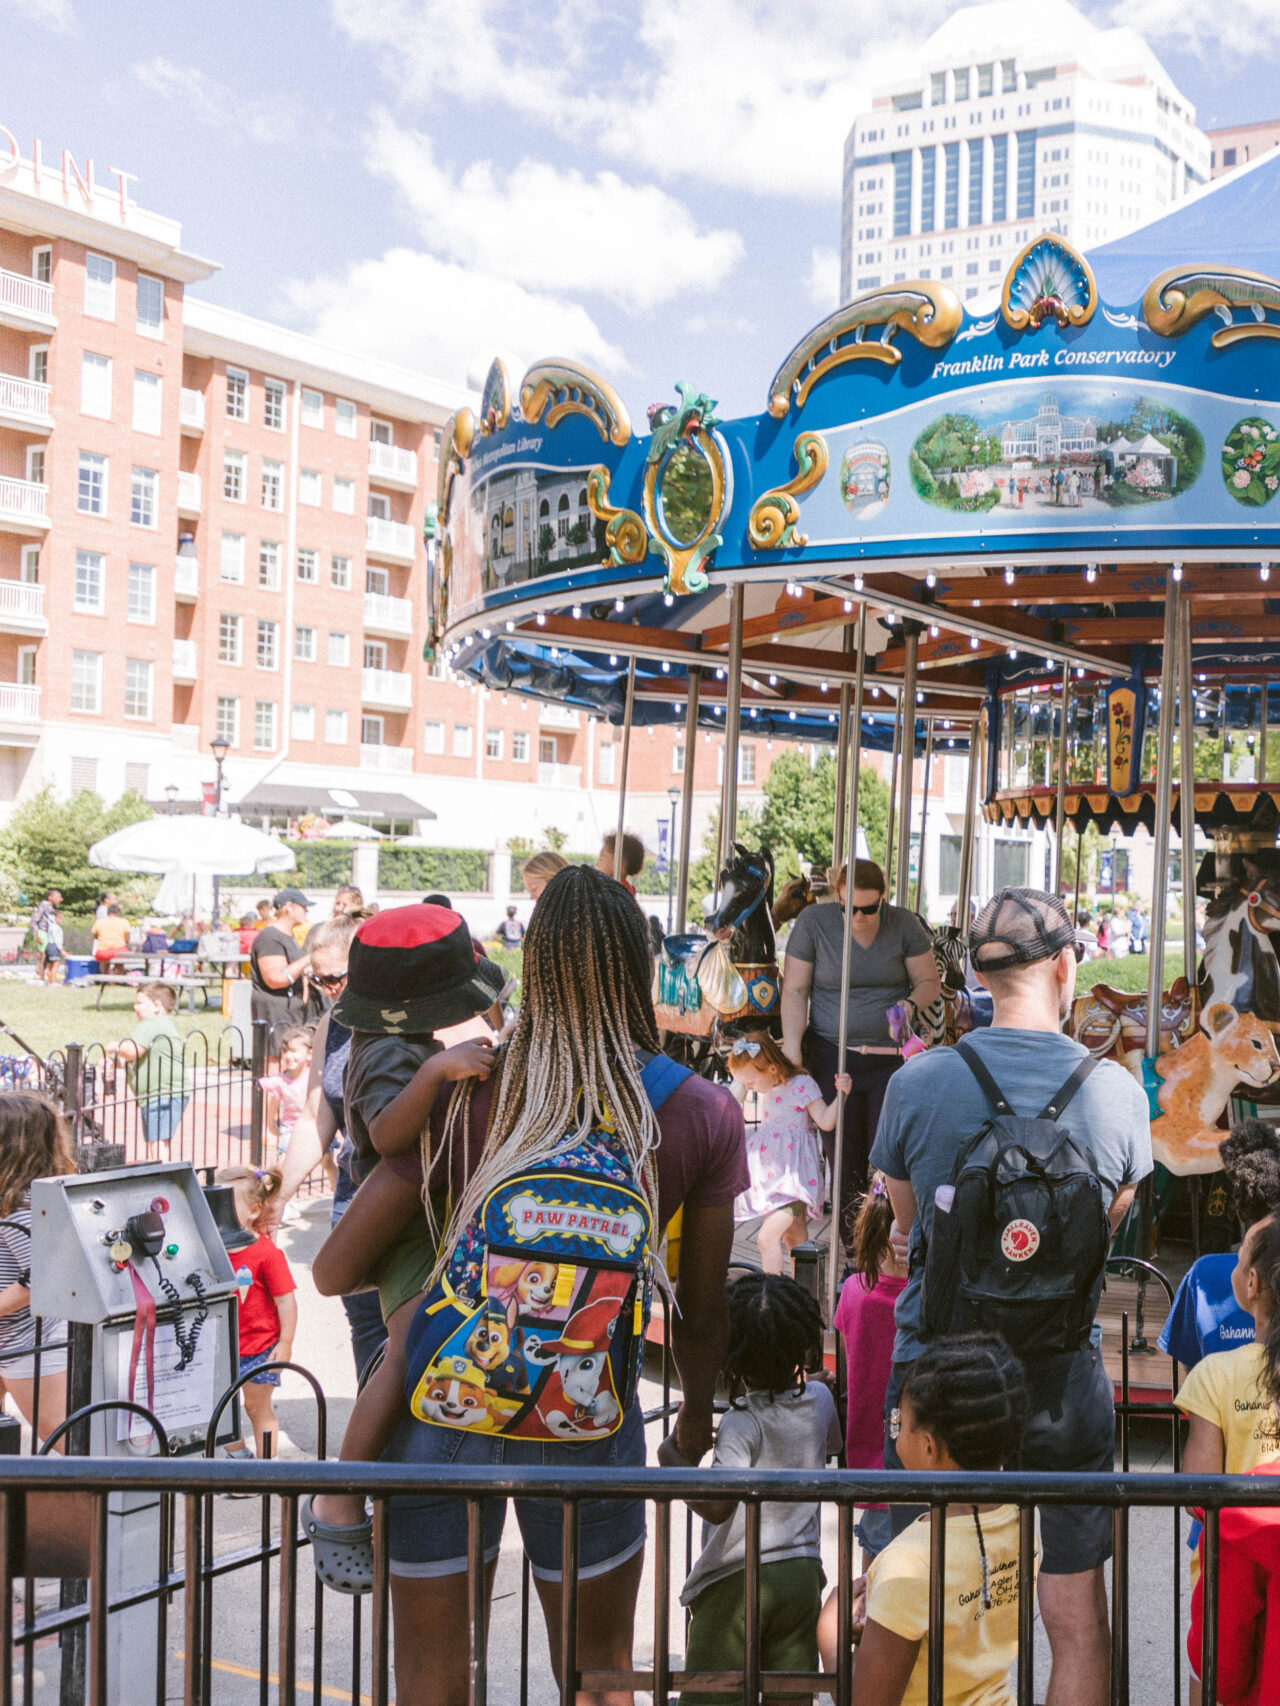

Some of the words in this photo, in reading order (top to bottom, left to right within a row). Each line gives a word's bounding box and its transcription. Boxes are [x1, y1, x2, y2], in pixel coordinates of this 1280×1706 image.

[931, 354, 1004, 379] Franklin
[1008, 349, 1049, 369] Park
[1054, 349, 1177, 368] Conservatory
[516, 436, 543, 453] Library
[523, 1210, 563, 1225] PAW
[567, 1214, 629, 1238] PATROL
[990, 1576, 1014, 1590] Agler
